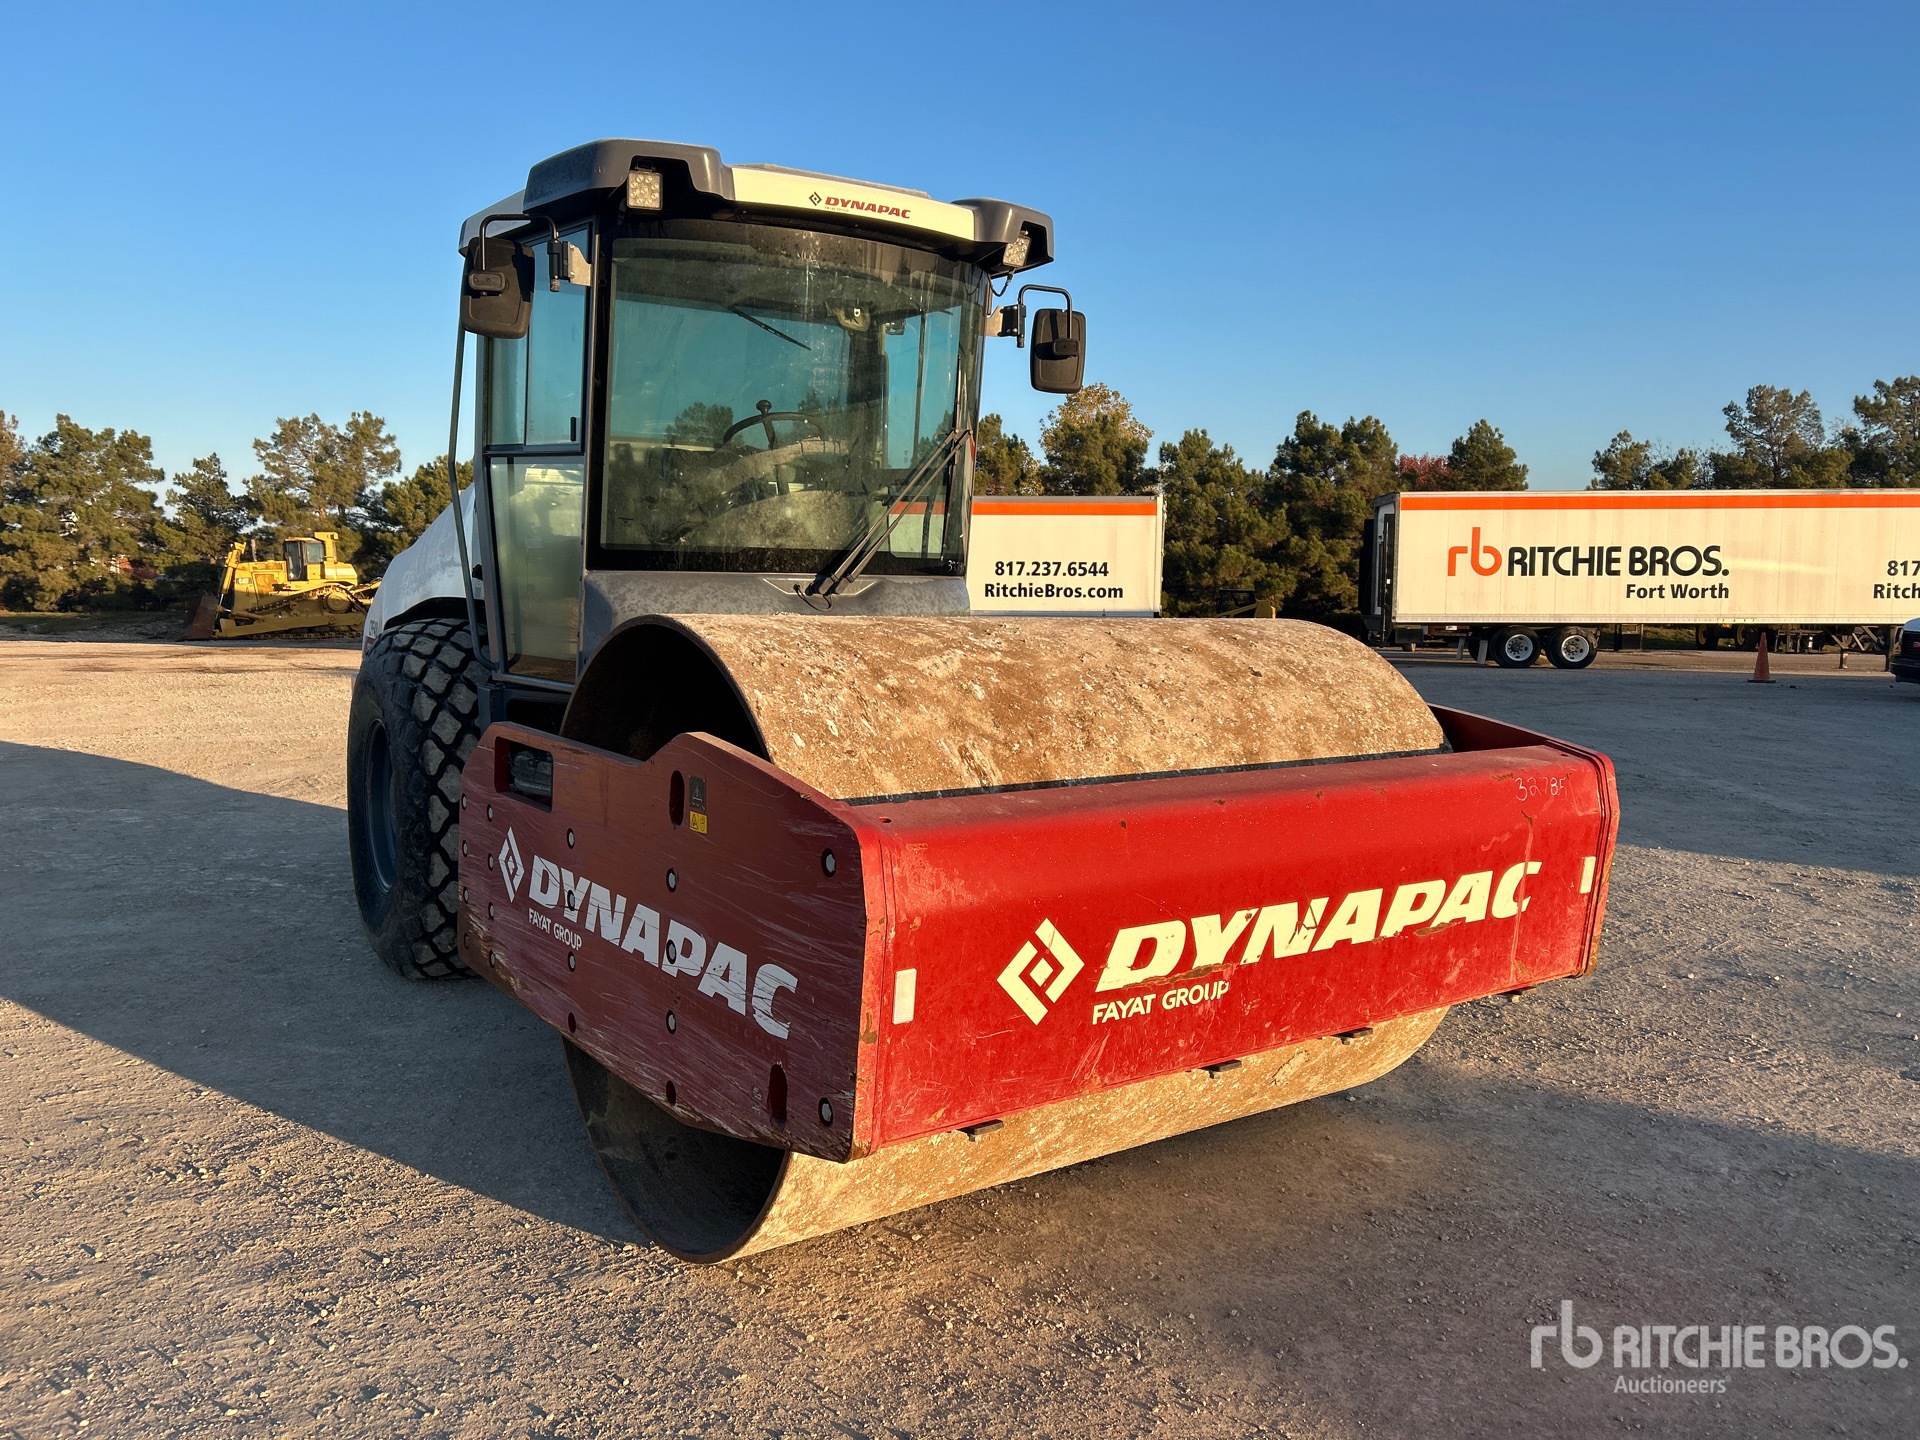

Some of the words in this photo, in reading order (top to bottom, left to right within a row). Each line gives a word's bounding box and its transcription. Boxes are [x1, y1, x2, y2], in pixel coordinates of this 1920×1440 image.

[825, 196, 911, 219] DYNAPAC
[1447, 526, 1503, 577] rb
[1507, 546, 1622, 577] RITCHIE
[1628, 545, 1730, 577] BROS.
[994, 561, 1109, 577] 817.237.6544
[984, 582, 1124, 598] RitchieBros.com
[1625, 583, 1665, 599] Fort
[1670, 582, 1729, 599] Worth
[1873, 582, 1920, 599] Ritch
[528, 907, 552, 934] FAYAT
[553, 922, 583, 951] GROUP
[1095, 861, 1543, 993] DYNAPAC
[528, 854, 799, 1040] DYNAPAC
[1091, 994, 1153, 1026] FAYAT
[1161, 980, 1230, 1011] GROUP
